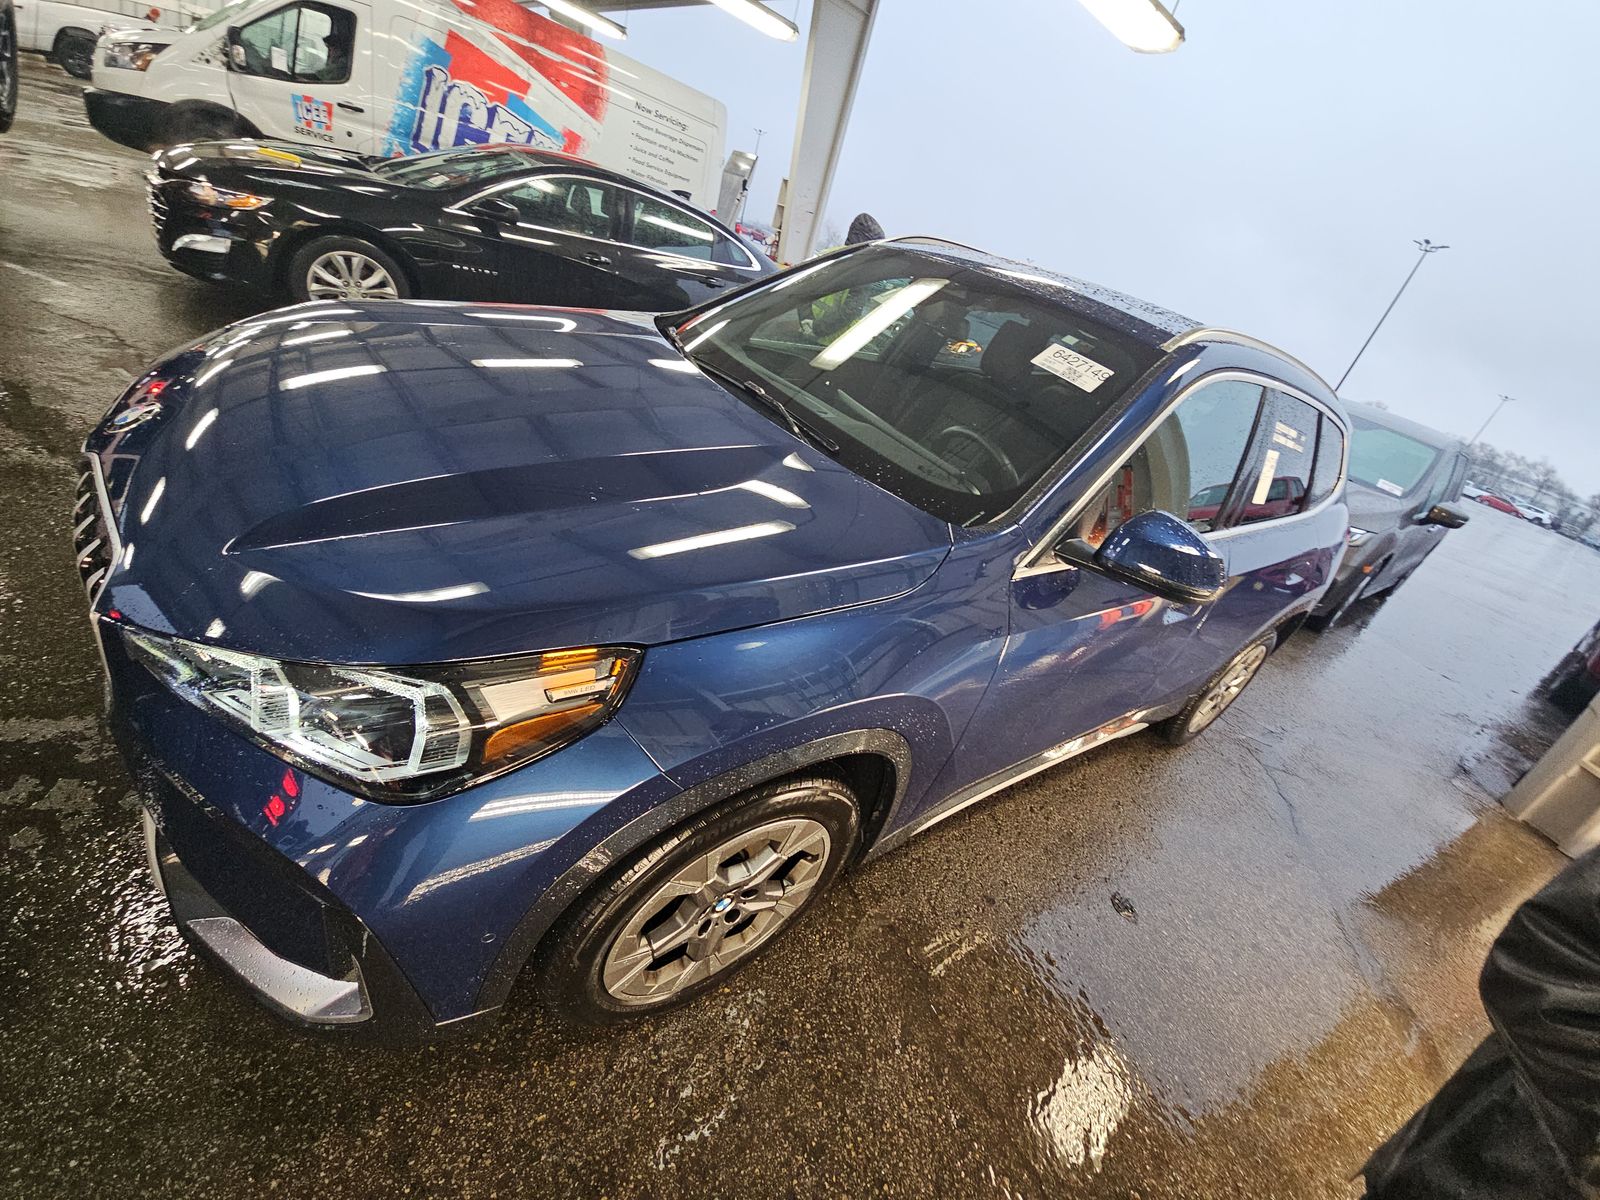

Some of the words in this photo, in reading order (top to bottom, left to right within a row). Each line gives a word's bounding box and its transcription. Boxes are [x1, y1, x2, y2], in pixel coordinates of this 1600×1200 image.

[296, 102, 328, 124] ICEE
[635, 101, 652, 114] Now
[654, 110, 689, 131] Servicing:
[294, 125, 335, 144] SERVICE
[1052, 349, 1110, 381] 6427149
